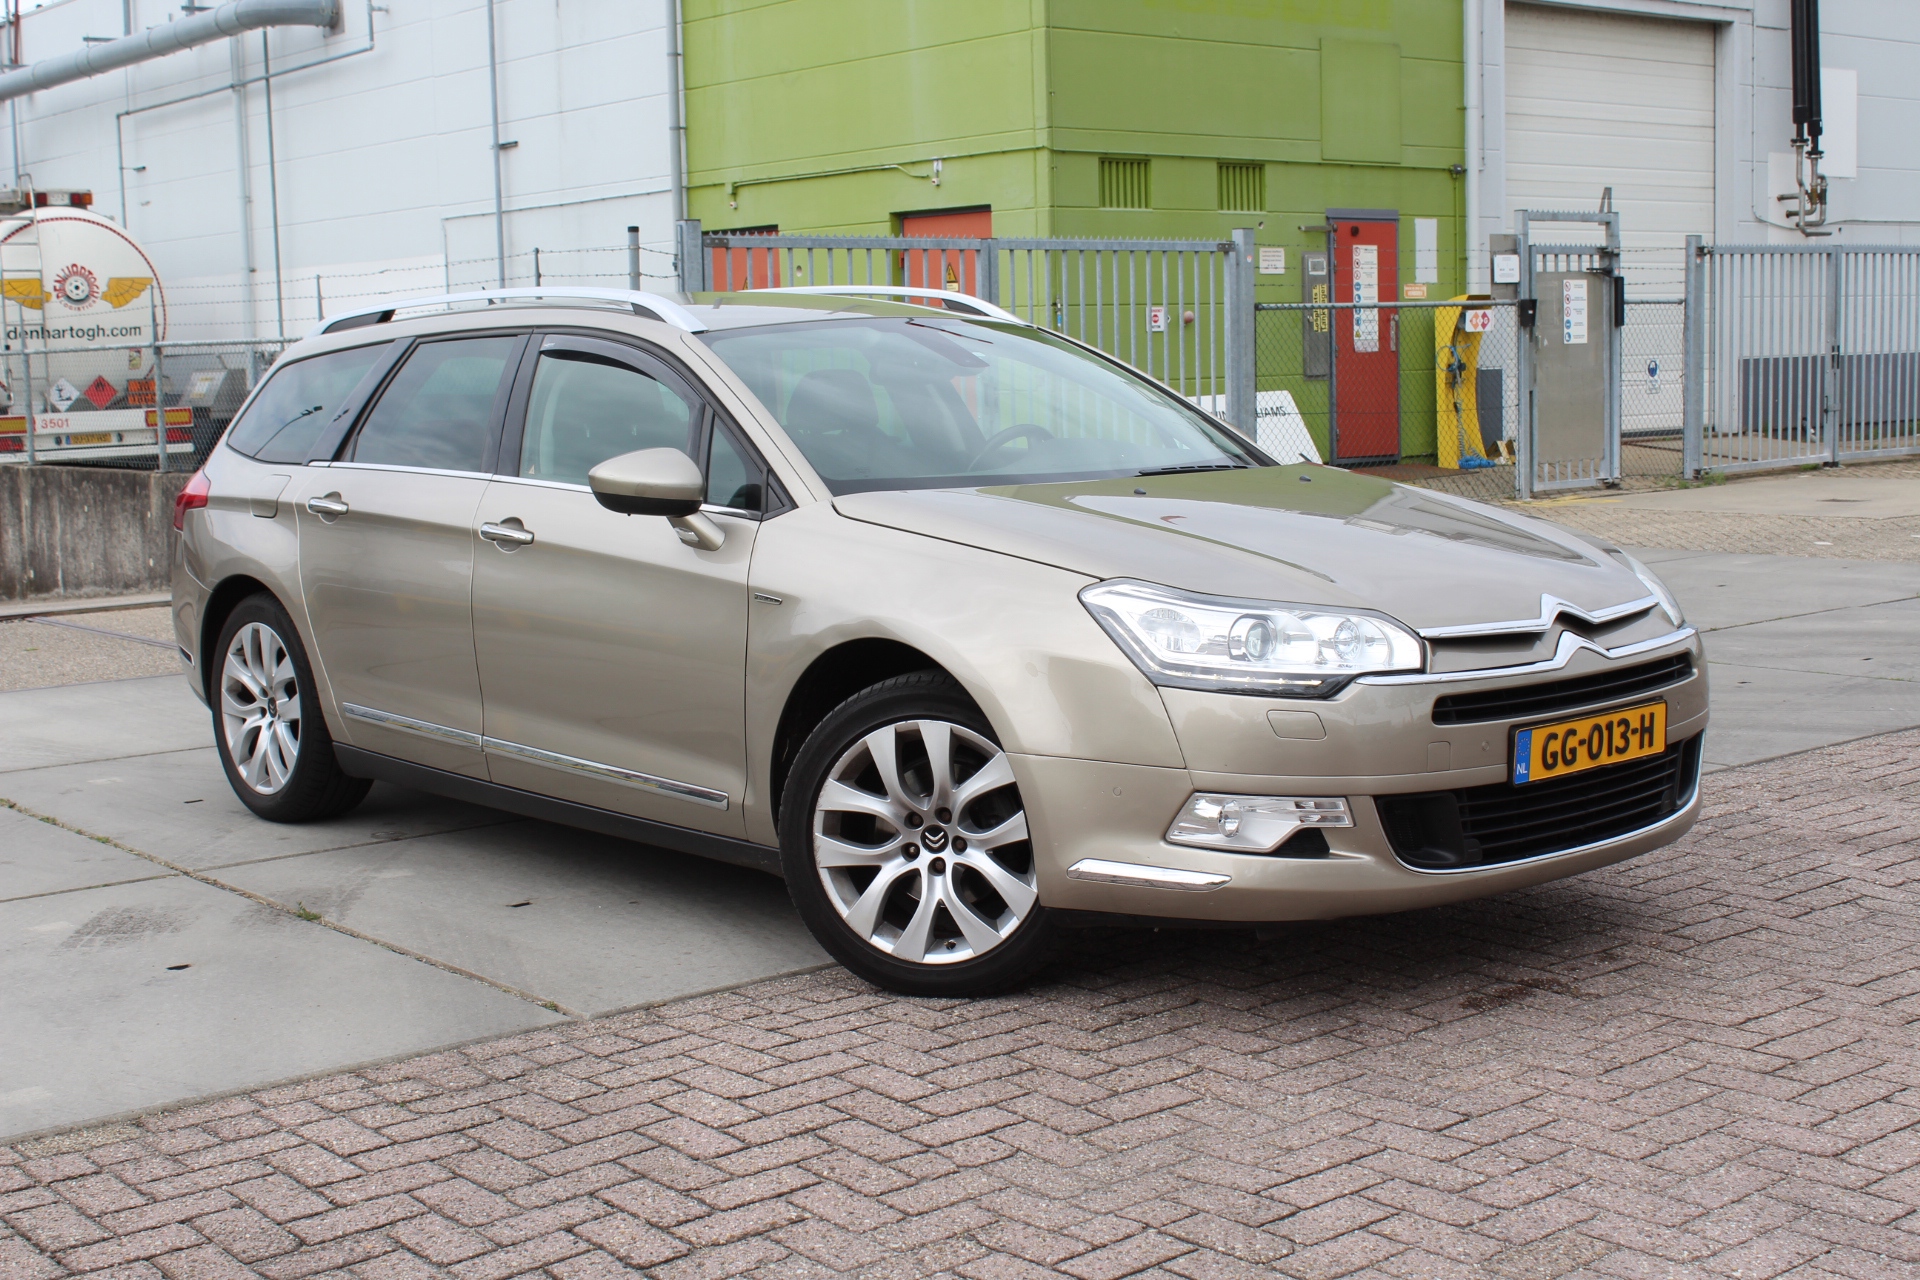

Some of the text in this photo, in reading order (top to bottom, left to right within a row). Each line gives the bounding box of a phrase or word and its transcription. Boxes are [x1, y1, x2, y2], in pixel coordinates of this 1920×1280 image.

[7, 325, 141, 341] denhartogh.com
[41, 418, 70, 429] 3501
[1542, 712, 1655, 770] GG-013-H
[1516, 763, 1528, 775] NL
